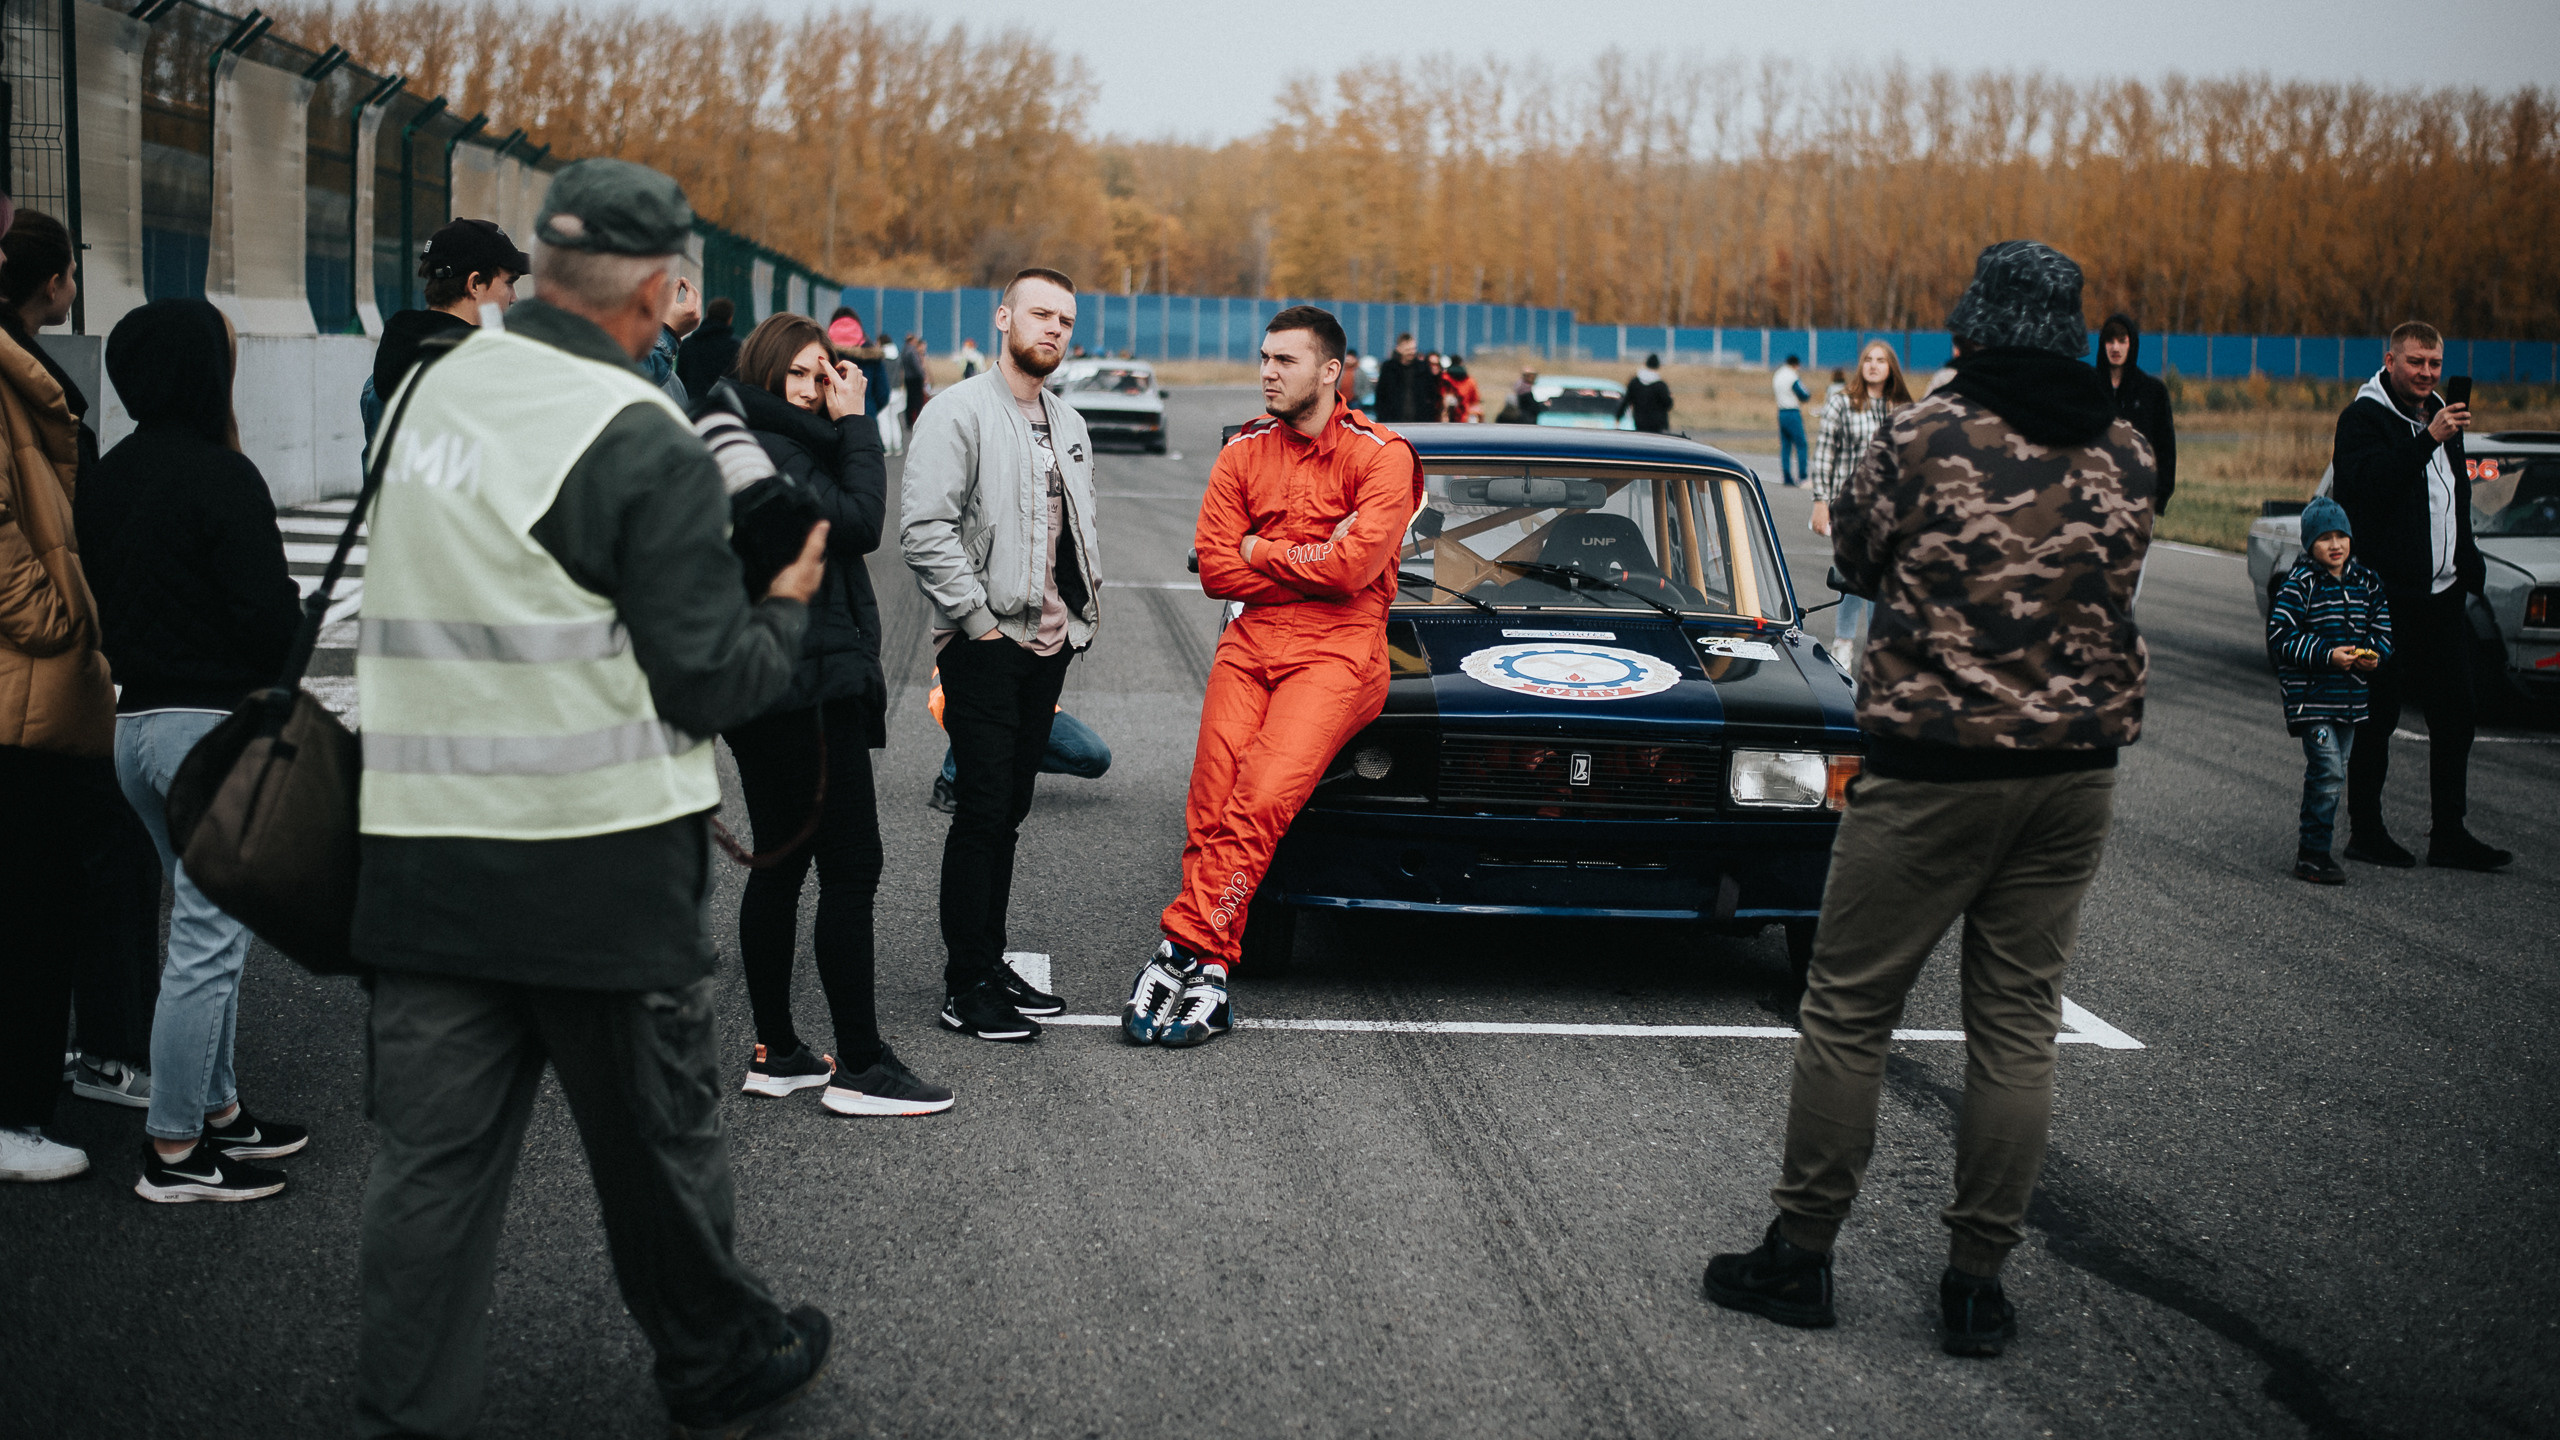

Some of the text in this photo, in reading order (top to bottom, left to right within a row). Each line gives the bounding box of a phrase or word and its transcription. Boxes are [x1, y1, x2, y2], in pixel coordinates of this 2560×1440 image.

[1581, 537, 1617, 546] UNP
[1286, 541, 1334, 565] OMP
[1536, 686, 1620, 698] КУЗГТУ
[1210, 871, 1249, 931] OMP
